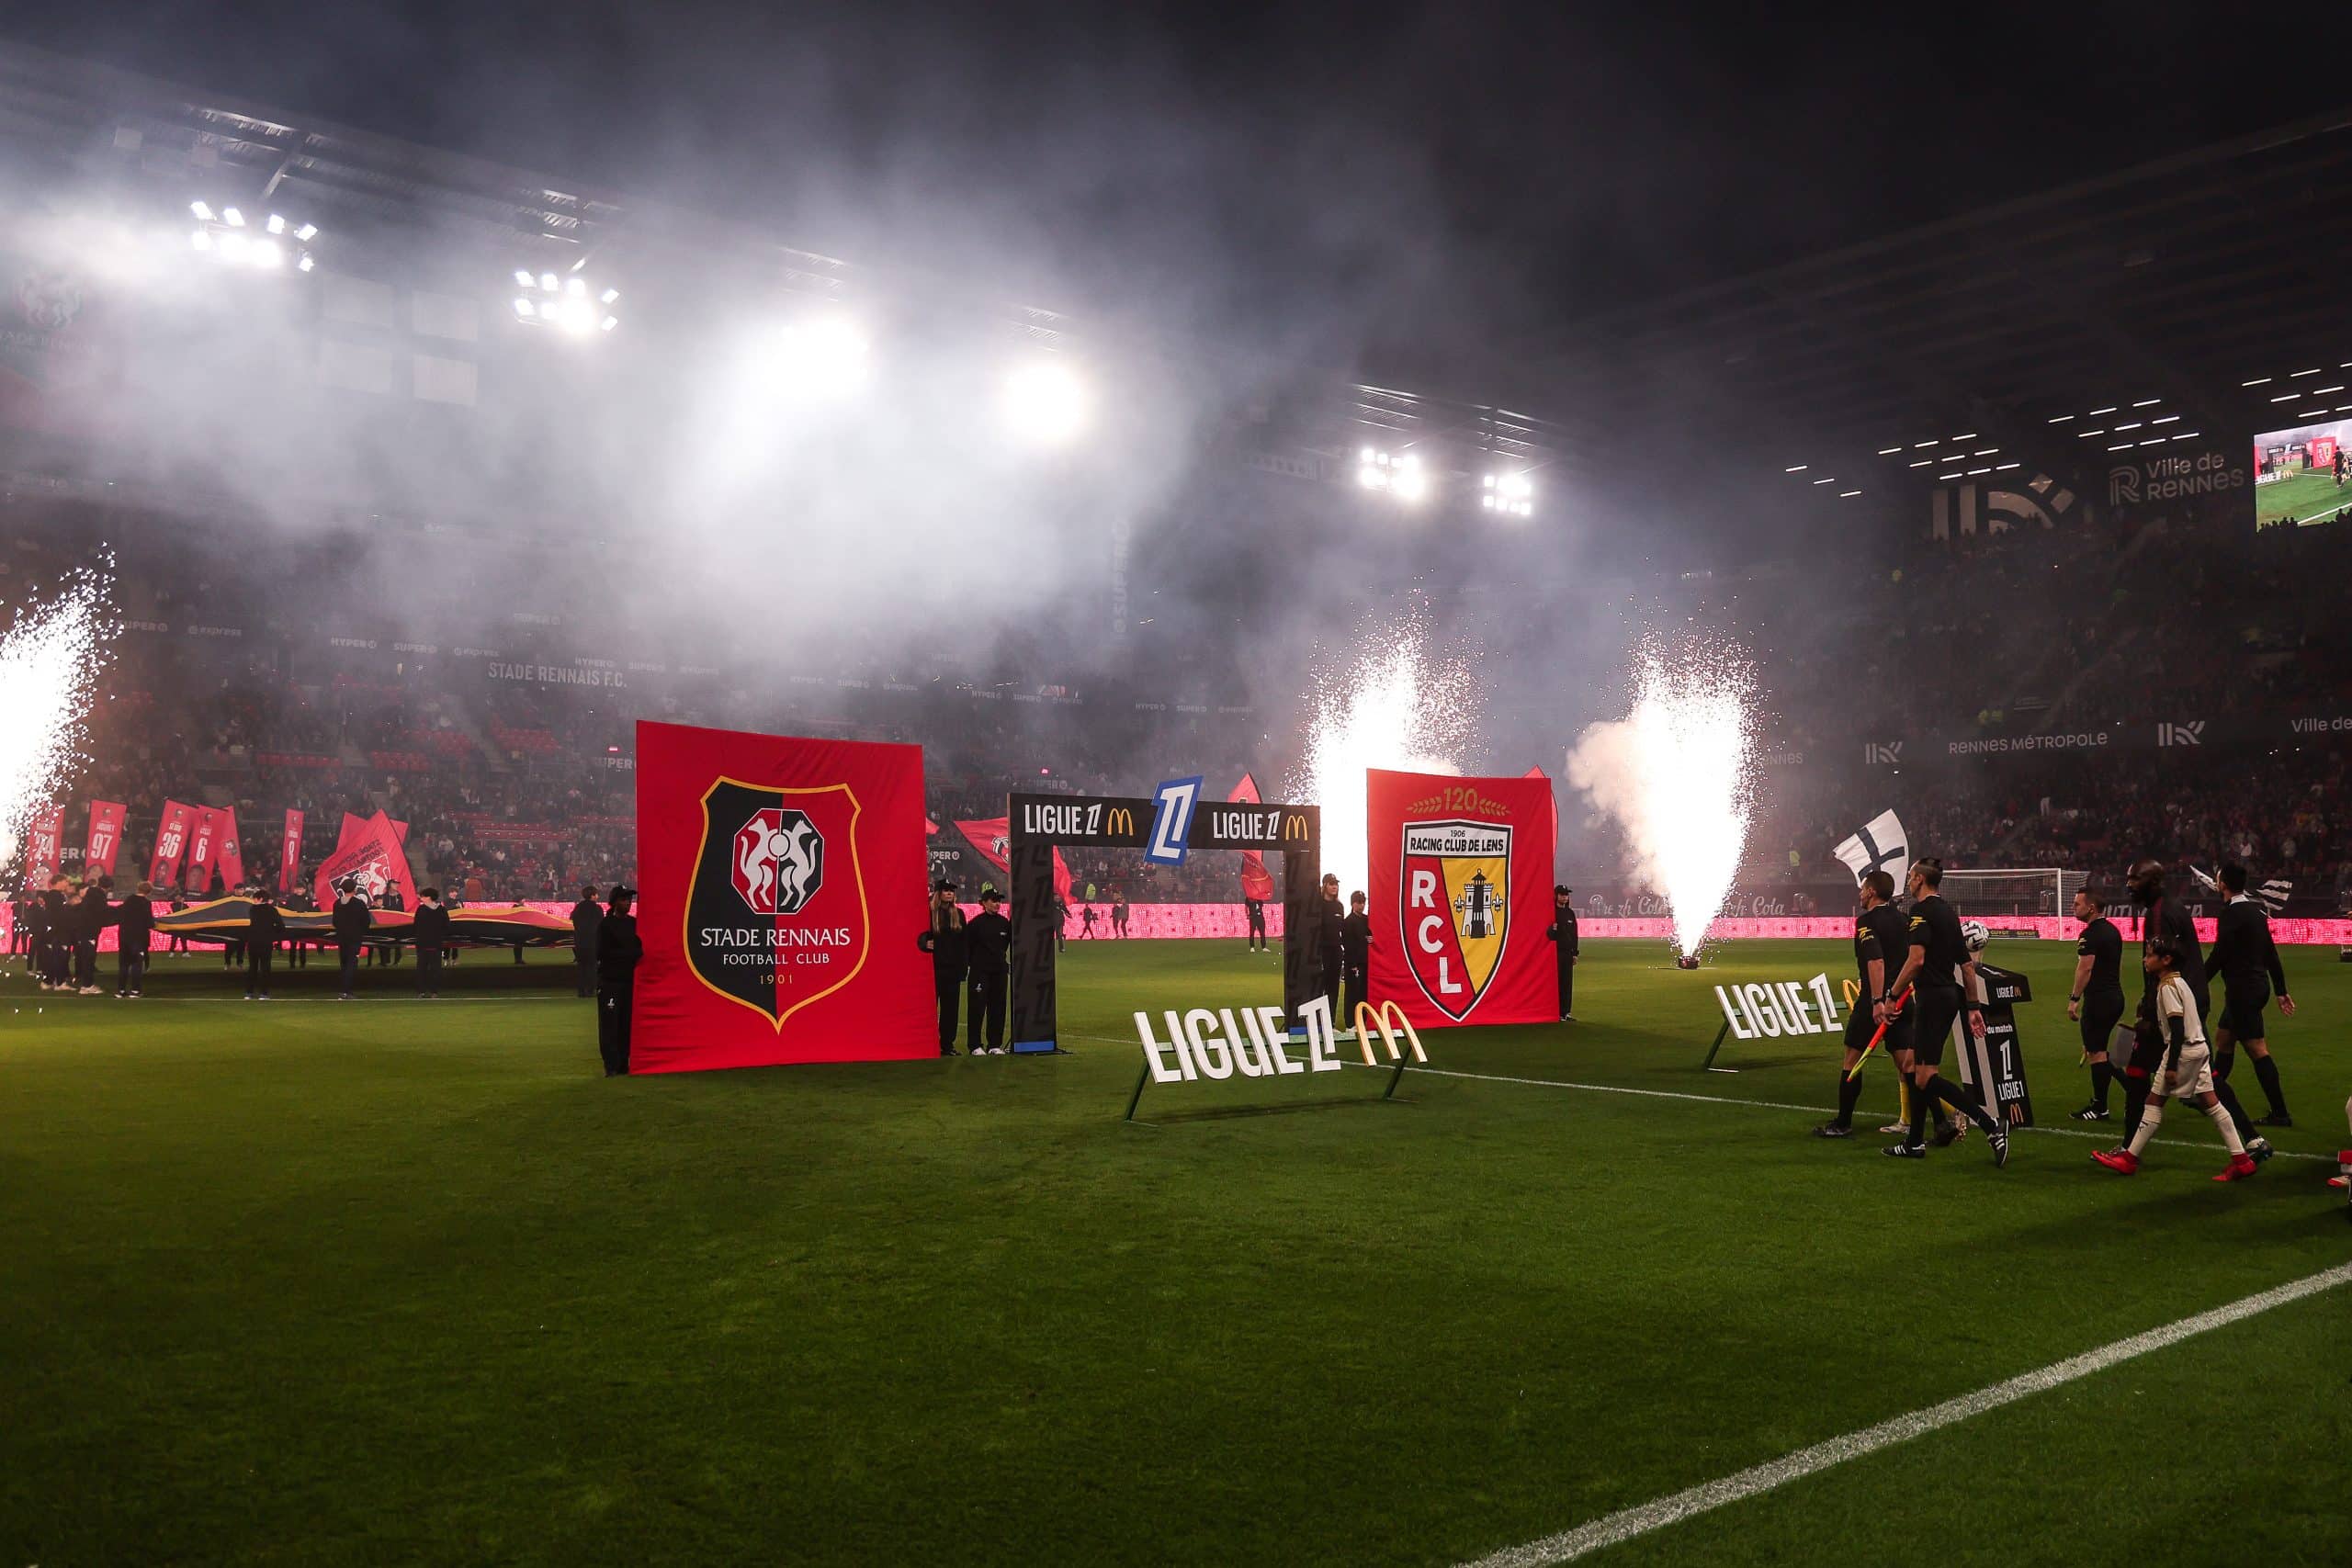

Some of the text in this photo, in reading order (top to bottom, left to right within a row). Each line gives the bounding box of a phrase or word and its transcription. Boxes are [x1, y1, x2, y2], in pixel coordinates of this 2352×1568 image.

[2146, 453, 2224, 479] Ville de
[331, 637, 366, 649] HYPER
[393, 642, 426, 654] SUPER
[489, 661, 628, 688] STADE RENNAIS F.C.
[2291, 716, 2352, 733] Ville de
[1443, 787, 1478, 812] 120
[1024, 805, 1082, 835] LIGUE
[1213, 811, 1264, 840] LIGUE
[1450, 829, 1466, 838] 1906
[90, 832, 113, 860] 97
[158, 831, 182, 858] 36
[196, 837, 208, 862] 6
[1410, 838, 1504, 852] RACING CLUB DE LENS
[1752, 896, 1786, 916] Cola
[700, 928, 851, 947] STADE RENNAIS
[723, 953, 831, 965] FOOTBALL CLUB
[759, 974, 793, 985] 1901
[1996, 987, 2010, 998] LIGUE
[1714, 982, 1822, 1040] LIGUE
[1987, 1023, 2013, 1034] du match
[1134, 1006, 1304, 1084] LIGUE
[1997, 1081, 2019, 1101] LIGUE
